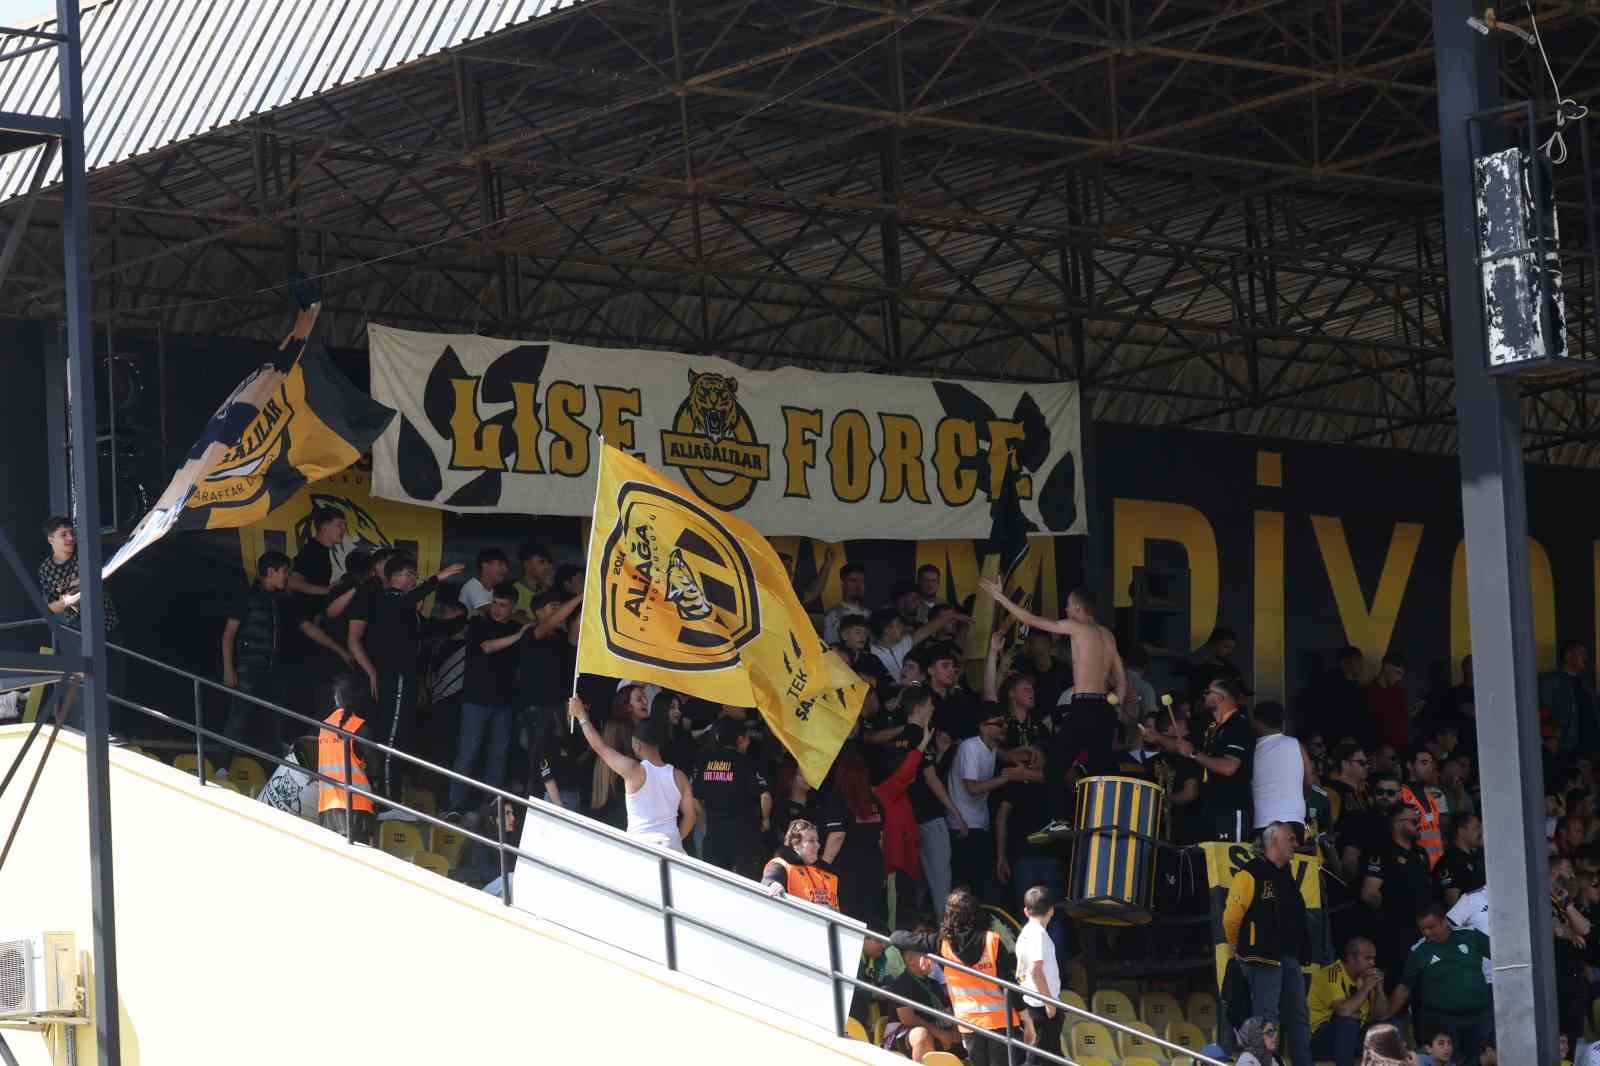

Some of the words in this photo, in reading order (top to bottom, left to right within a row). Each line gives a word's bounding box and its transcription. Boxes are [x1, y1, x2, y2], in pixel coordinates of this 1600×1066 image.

[781, 405, 1033, 508] FORCE
[623, 524, 653, 618] ALİAĞA
[786, 668, 807, 698] TEK
[794, 697, 817, 721] ŞA
